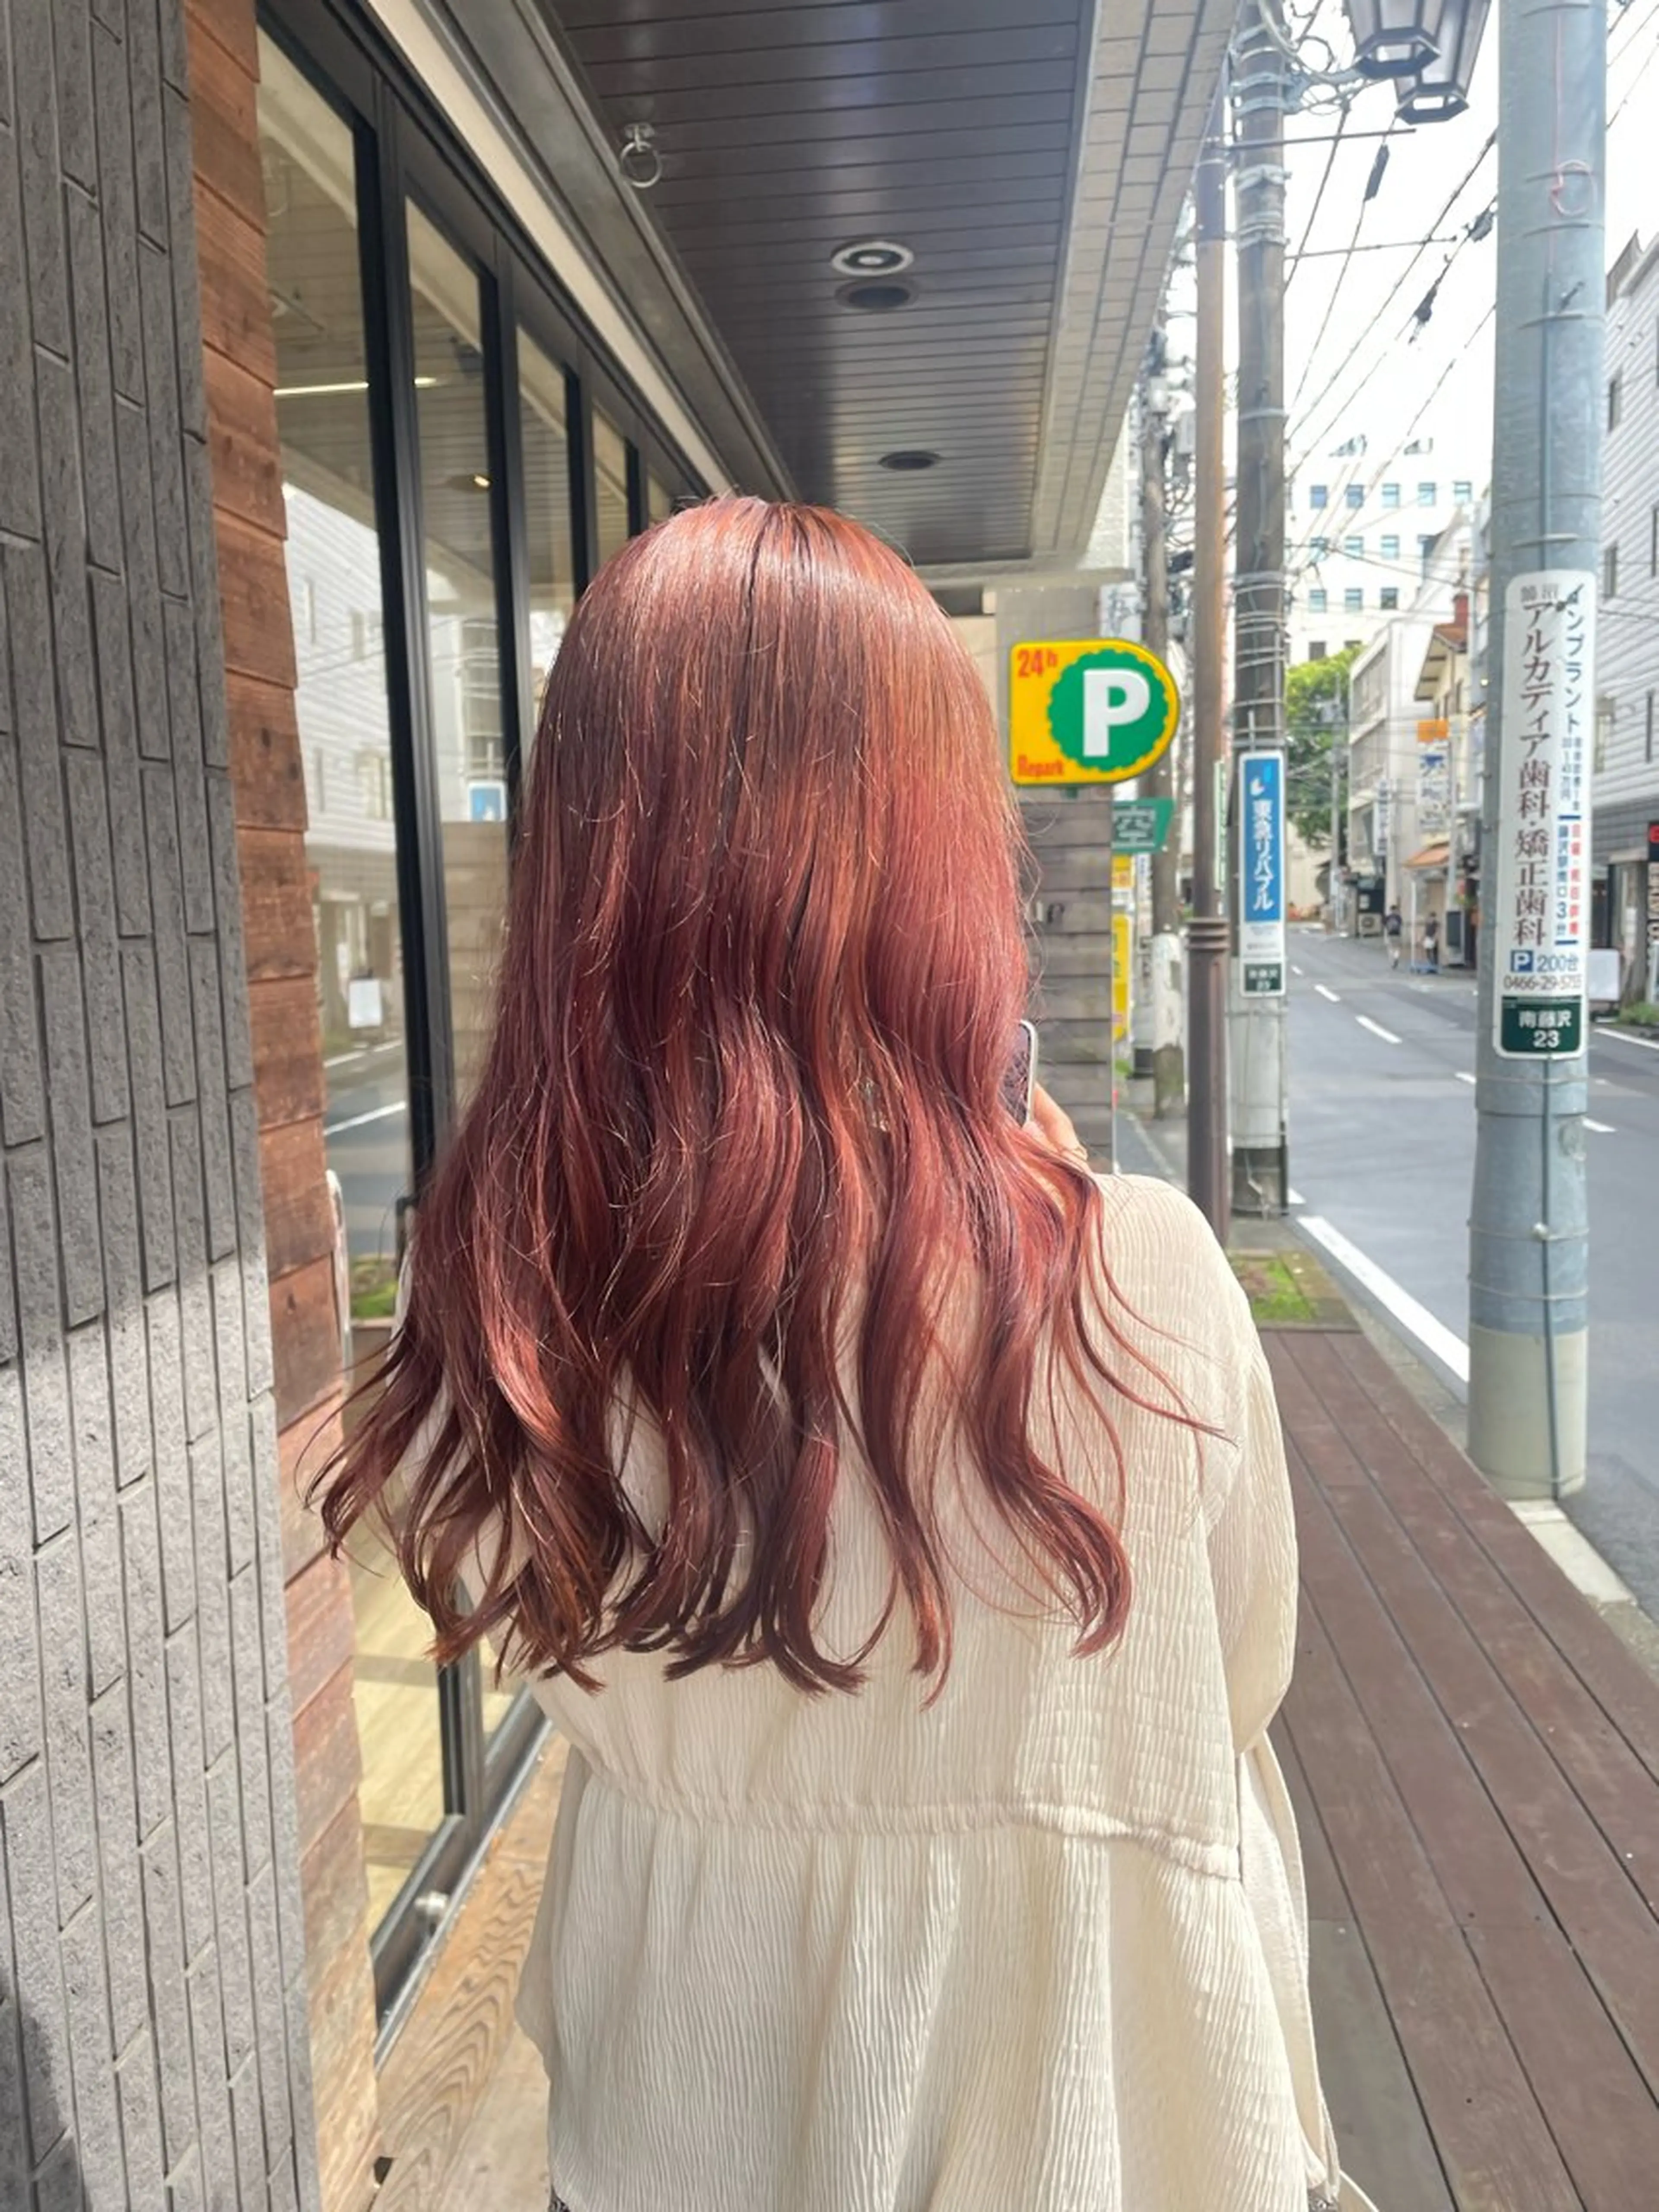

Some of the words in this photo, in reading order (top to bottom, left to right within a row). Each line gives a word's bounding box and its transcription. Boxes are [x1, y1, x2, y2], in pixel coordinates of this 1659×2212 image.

[1083, 669, 1150, 757] P
[1111, 804, 1156, 849] 空
[1533, 1030, 1560, 1048] 23
